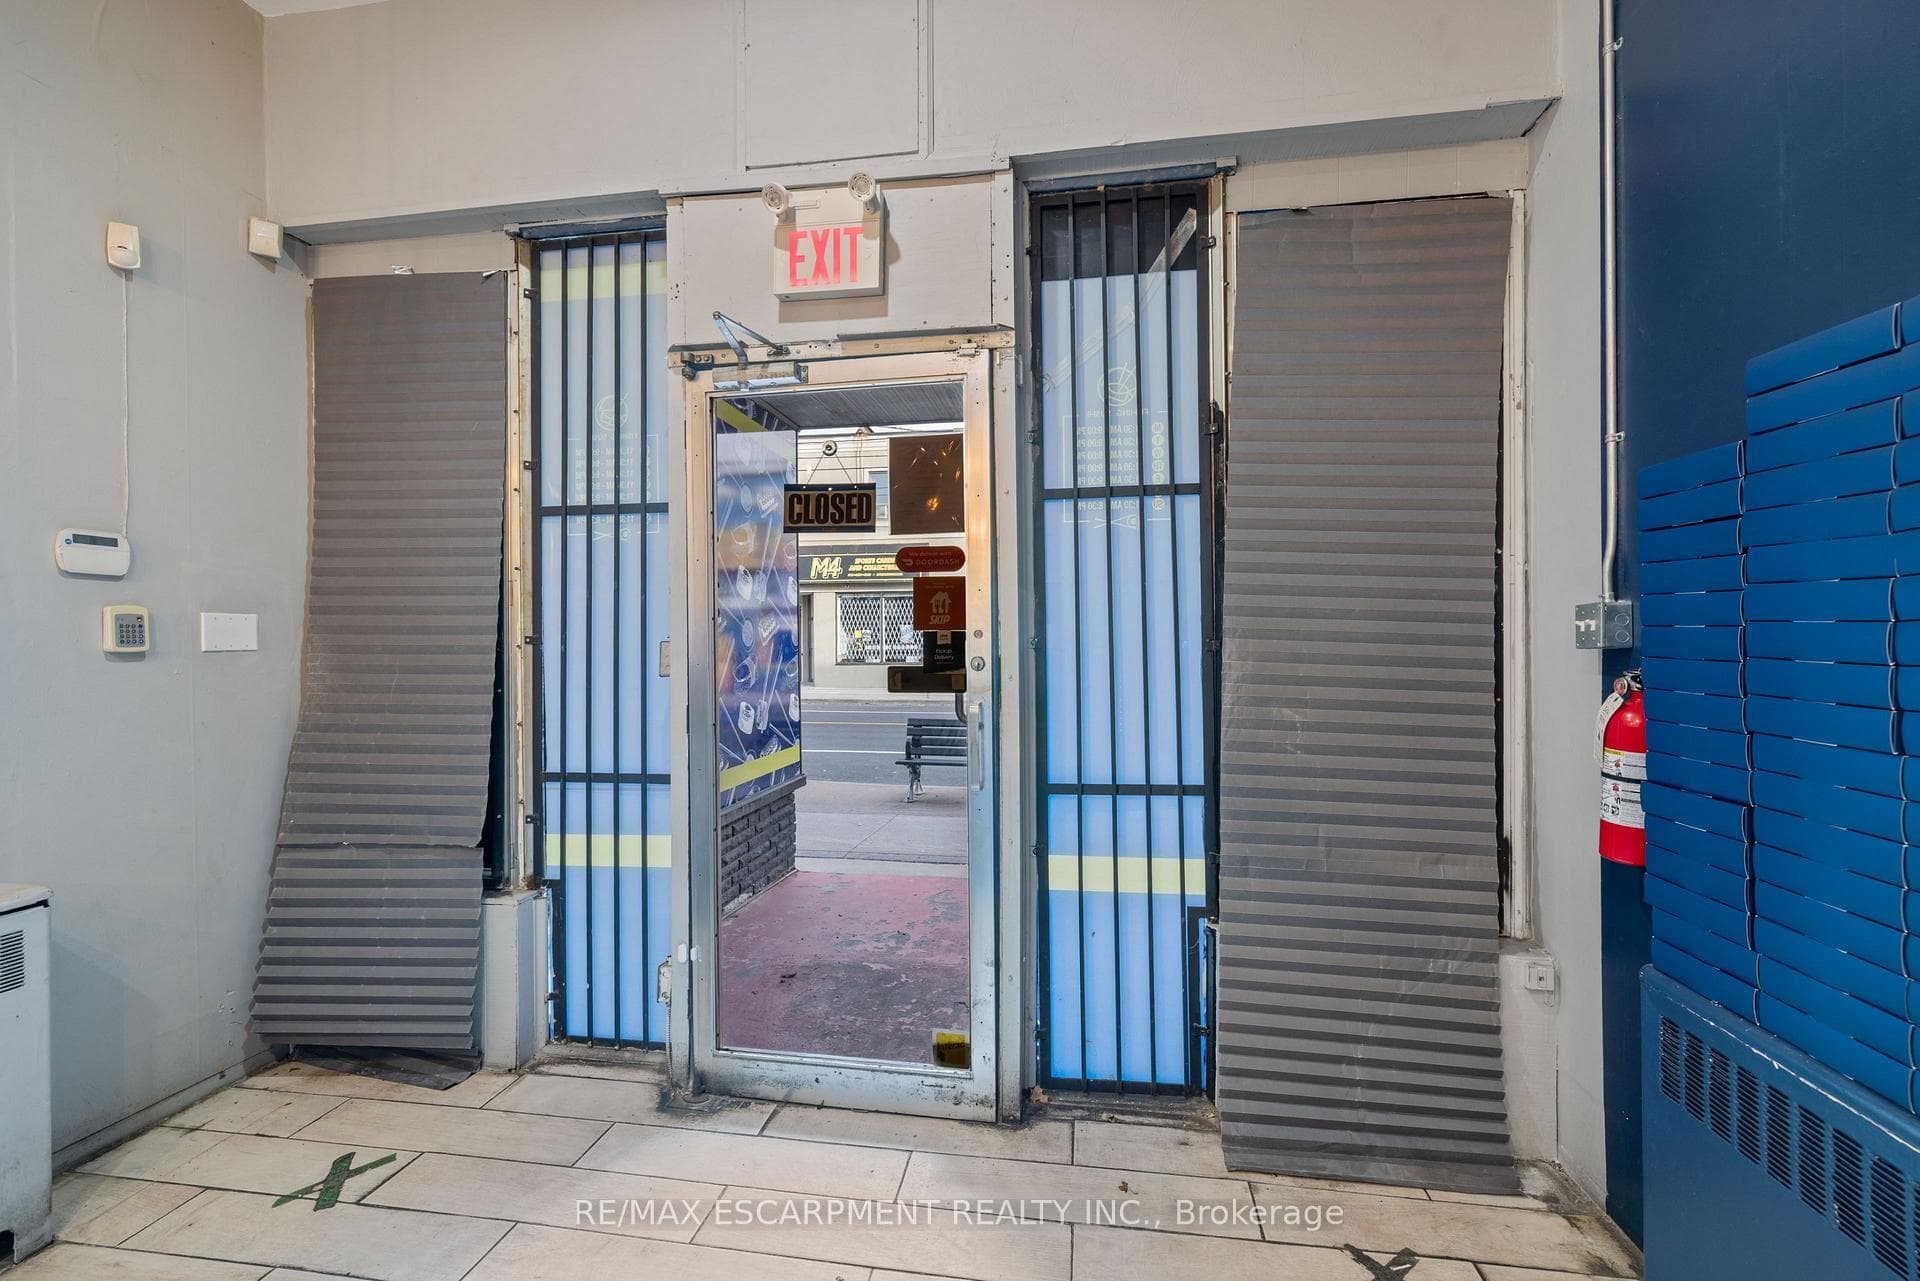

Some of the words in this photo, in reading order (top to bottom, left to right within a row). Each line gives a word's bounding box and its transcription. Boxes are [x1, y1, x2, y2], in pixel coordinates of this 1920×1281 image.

[788, 226, 864, 287] EXIT
[788, 492, 872, 525] CLOSED
[810, 556, 843, 580] M4
[929, 615, 951, 625] SKIP
